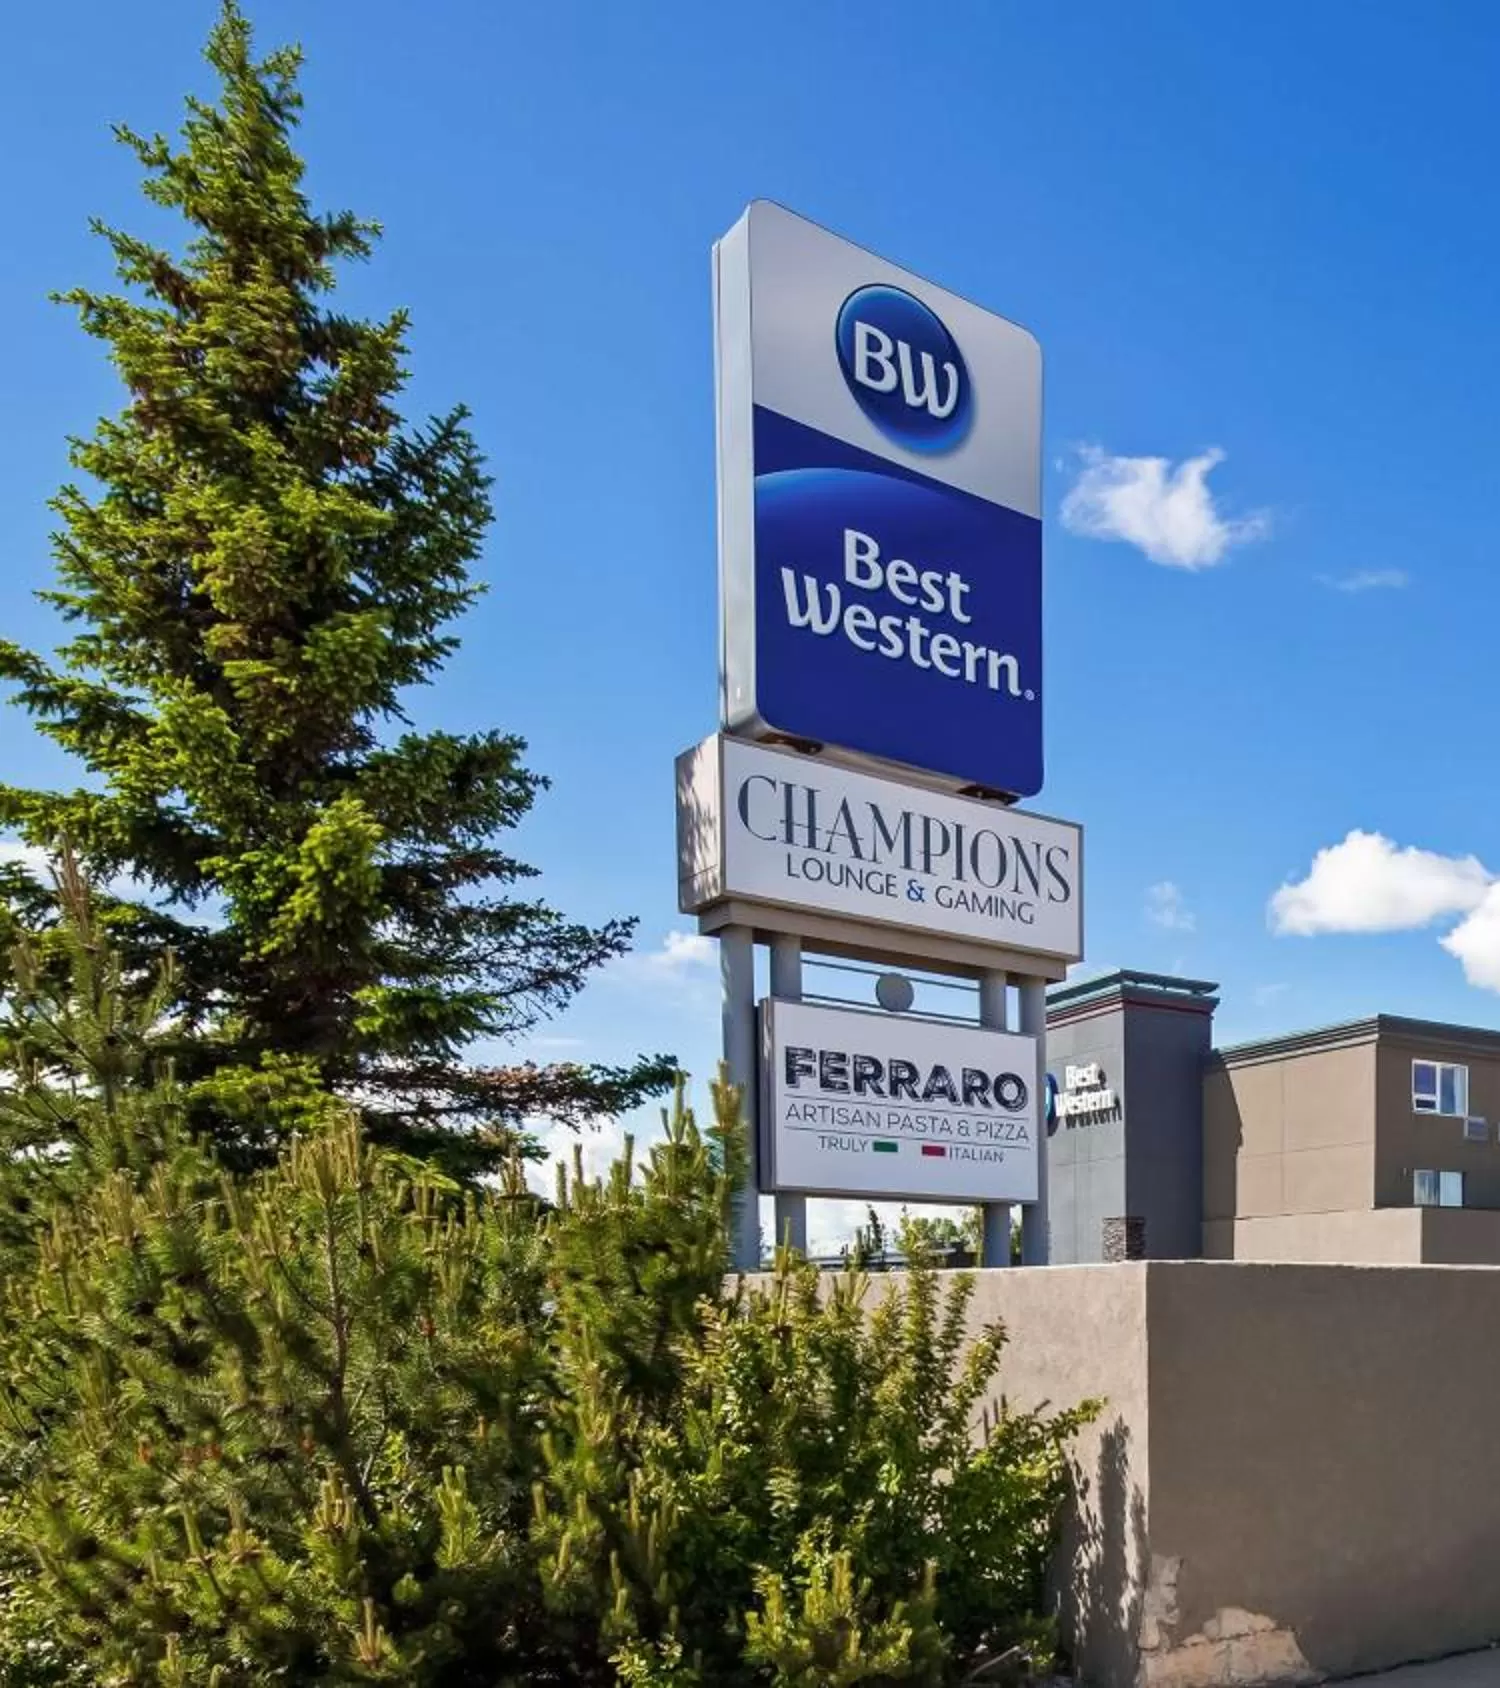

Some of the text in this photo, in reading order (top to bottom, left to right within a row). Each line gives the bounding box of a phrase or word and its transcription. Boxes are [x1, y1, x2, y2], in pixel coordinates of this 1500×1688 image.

[854, 320, 959, 420] BW
[843, 528, 971, 624] Best
[737, 775, 1072, 903] CHAMPIONS
[786, 852, 1035, 925] LOUNGE & GAMING
[784, 1045, 1029, 1112] FERRARO
[785, 1103, 1030, 1142] ARTISAN PASTA & PIZZA
[818, 1135, 1004, 1163] TRULY ITALIAN
